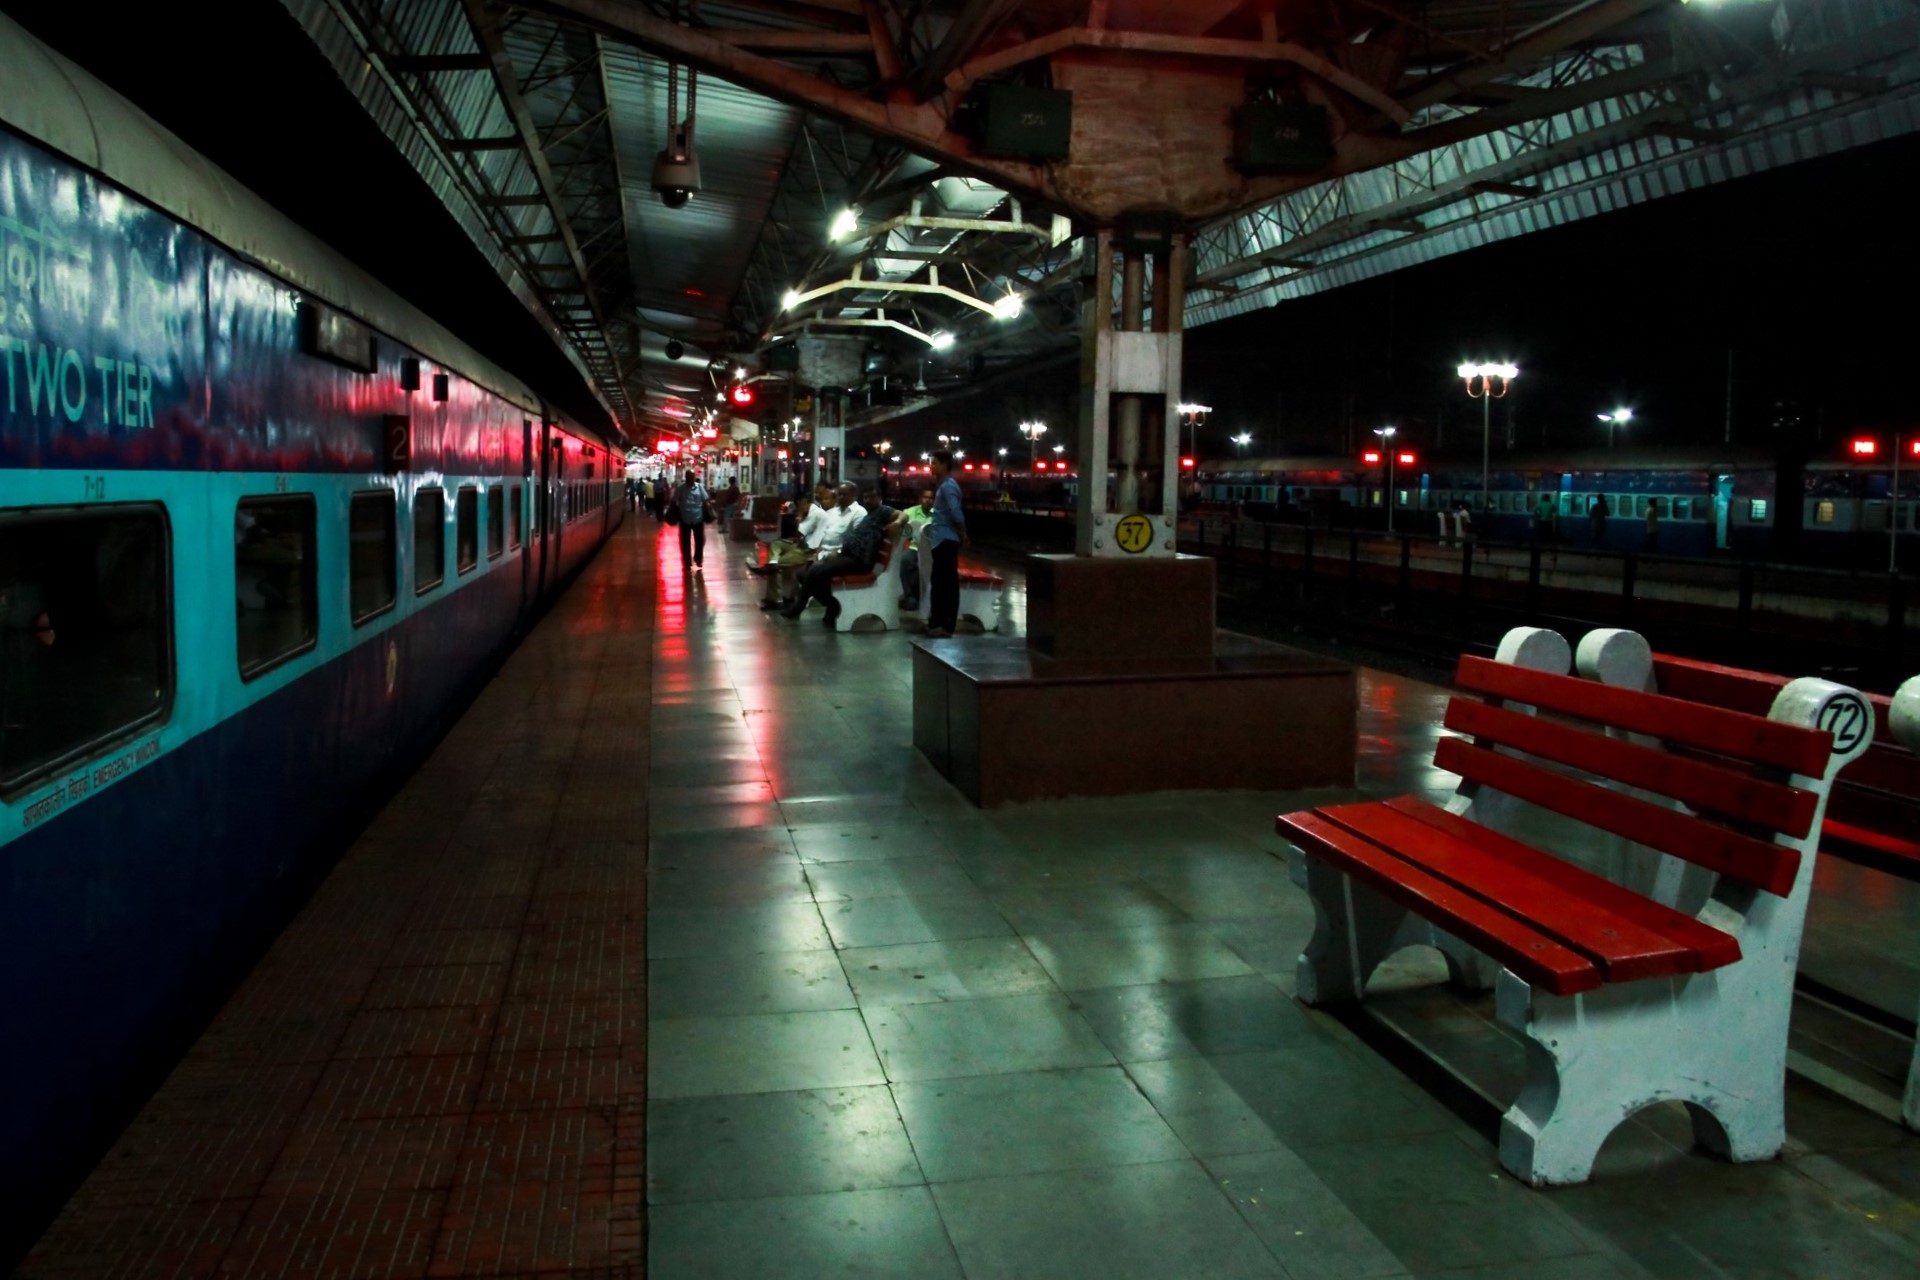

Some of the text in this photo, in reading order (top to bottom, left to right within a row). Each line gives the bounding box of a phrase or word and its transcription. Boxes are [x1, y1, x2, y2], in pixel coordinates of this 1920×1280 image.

[0, 334, 155, 429] TWO TIER
[391, 425, 408, 461] 2
[1828, 703, 1860, 741] 72
